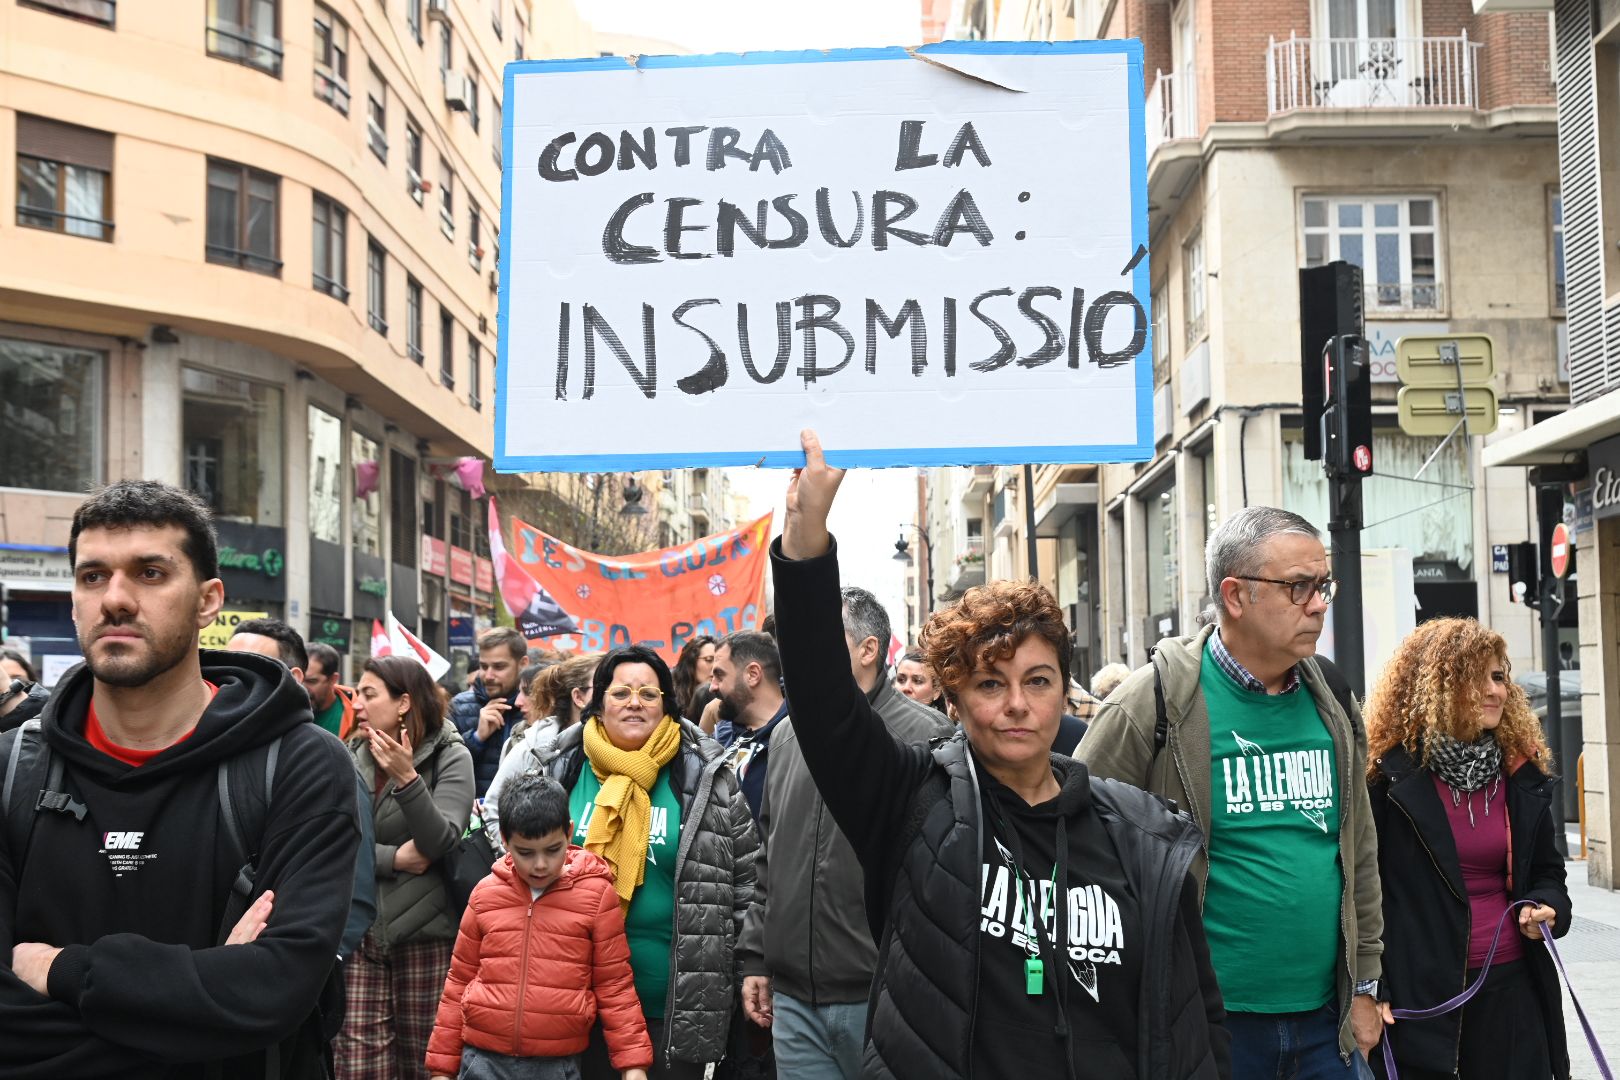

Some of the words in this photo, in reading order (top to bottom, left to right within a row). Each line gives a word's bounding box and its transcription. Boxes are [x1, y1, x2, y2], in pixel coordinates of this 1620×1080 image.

[538, 125, 792, 182] CONTRA
[894, 120, 992, 171] LA
[602, 186, 1031, 265] CENSURA:
[555, 243, 1148, 401] INSUBMISSIÓ
[1223, 757, 1252, 803] LA
[1253, 749, 1333, 802] LLENGUA
[1226, 803, 1254, 814] NO
[1260, 801, 1284, 812] ES
[1290, 798, 1333, 810] TOCA
[1067, 946, 1121, 965] OCA
